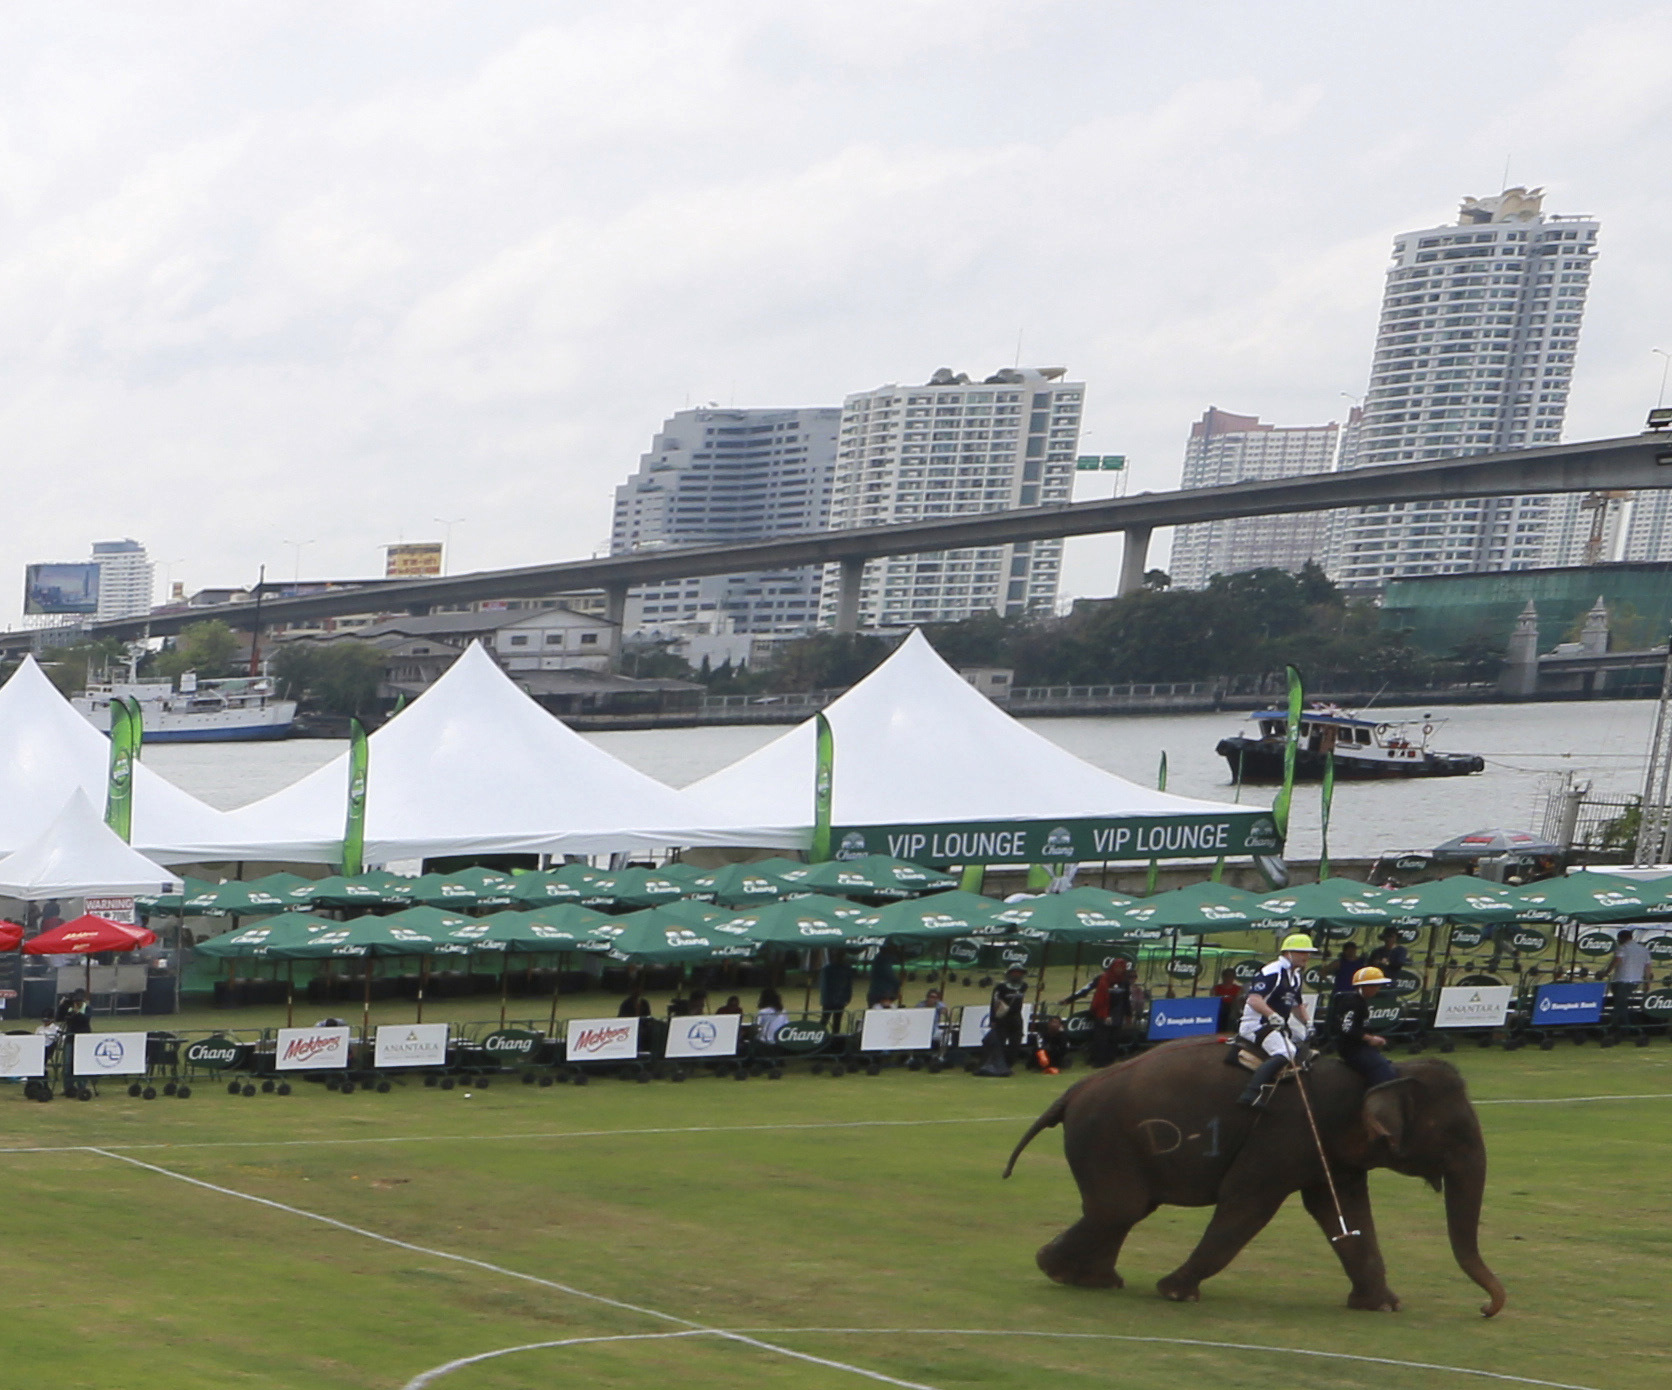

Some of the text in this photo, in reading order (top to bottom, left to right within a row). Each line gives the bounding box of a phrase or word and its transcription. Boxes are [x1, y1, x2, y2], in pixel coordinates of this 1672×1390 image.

[887, 834, 926, 858] VIP
[932, 831, 1027, 857] LOUNGE
[1042, 841, 1074, 857] Chang
[1092, 828, 1131, 852] VIP
[1136, 824, 1230, 850] LOUNGE
[1244, 833, 1277, 849] Chang
[1397, 856, 1427, 870] Chang
[87, 899, 133, 909] WARNING
[667, 936, 709, 946] Chang
[1514, 933, 1544, 949] Chang
[1580, 937, 1613, 952] Chang
[1003, 949, 1029, 964] Chang
[1446, 1003, 1501, 1013] ANANTARA
[574, 1027, 630, 1052] Mekhong
[778, 1027, 824, 1043] Chang
[282, 1035, 341, 1062] Mekhong
[384, 1043, 438, 1052] ANANTARA
[485, 1035, 532, 1052] Chang
[188, 1045, 236, 1062] Chang
